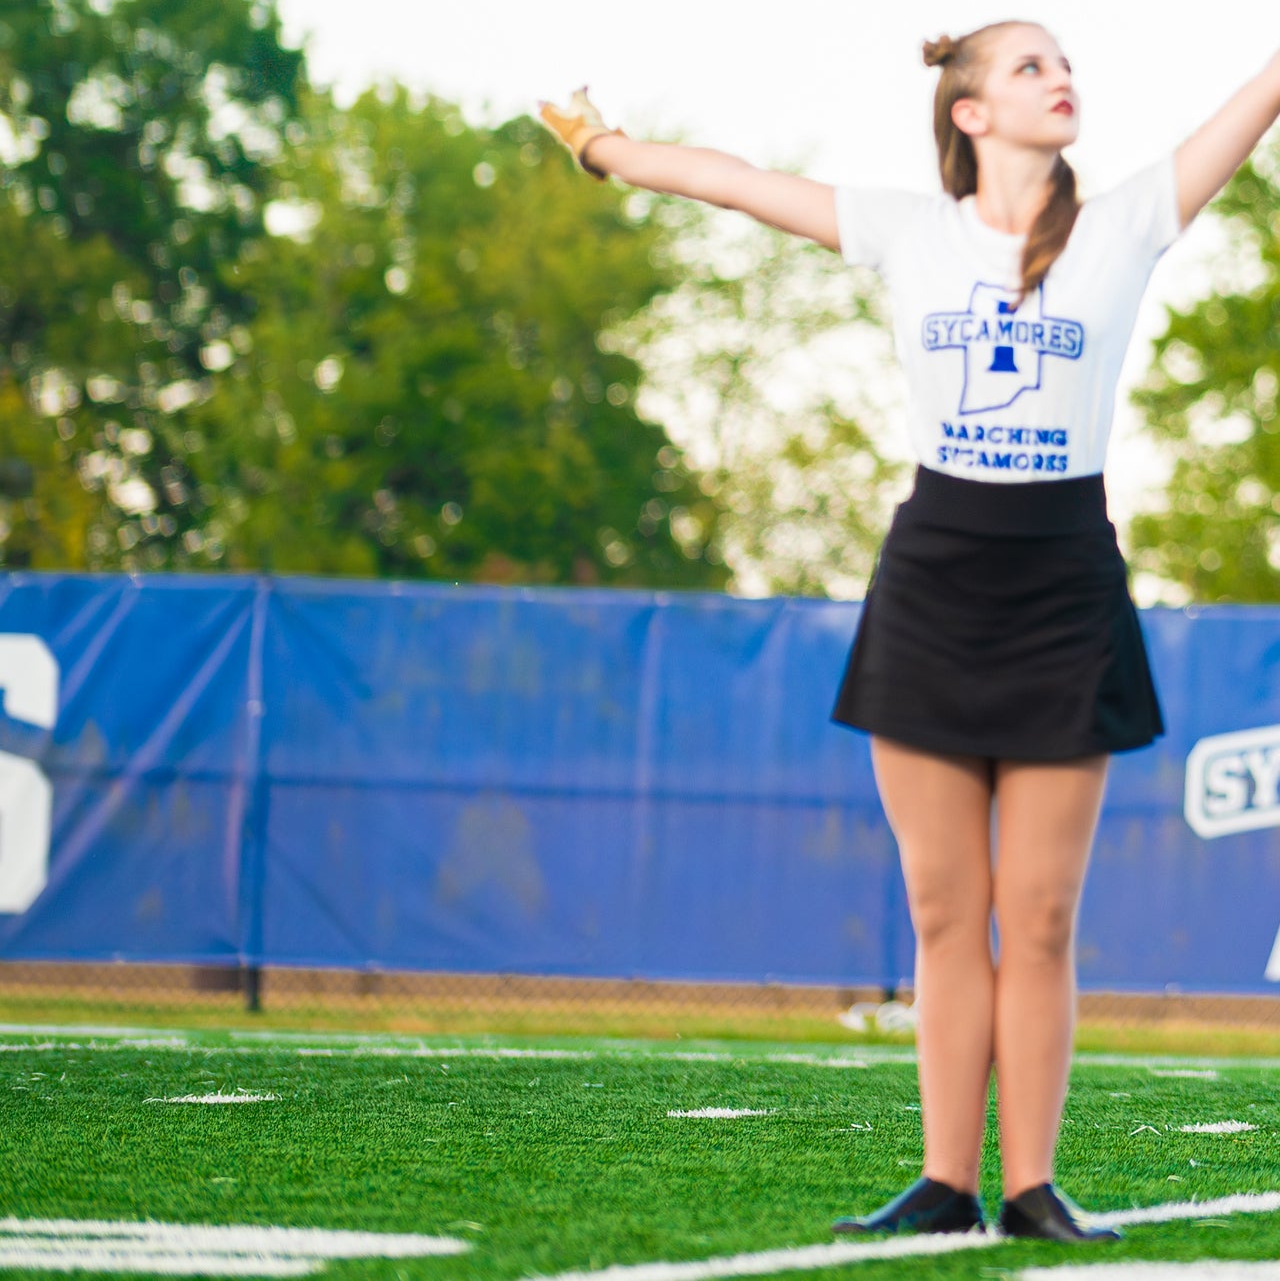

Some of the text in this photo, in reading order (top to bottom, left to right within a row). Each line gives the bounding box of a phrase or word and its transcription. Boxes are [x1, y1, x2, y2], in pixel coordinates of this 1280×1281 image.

[926, 320, 1078, 352] SYCAMORES
[940, 422, 1068, 447] MARCHING
[938, 447, 1068, 471] SYCAMORES
